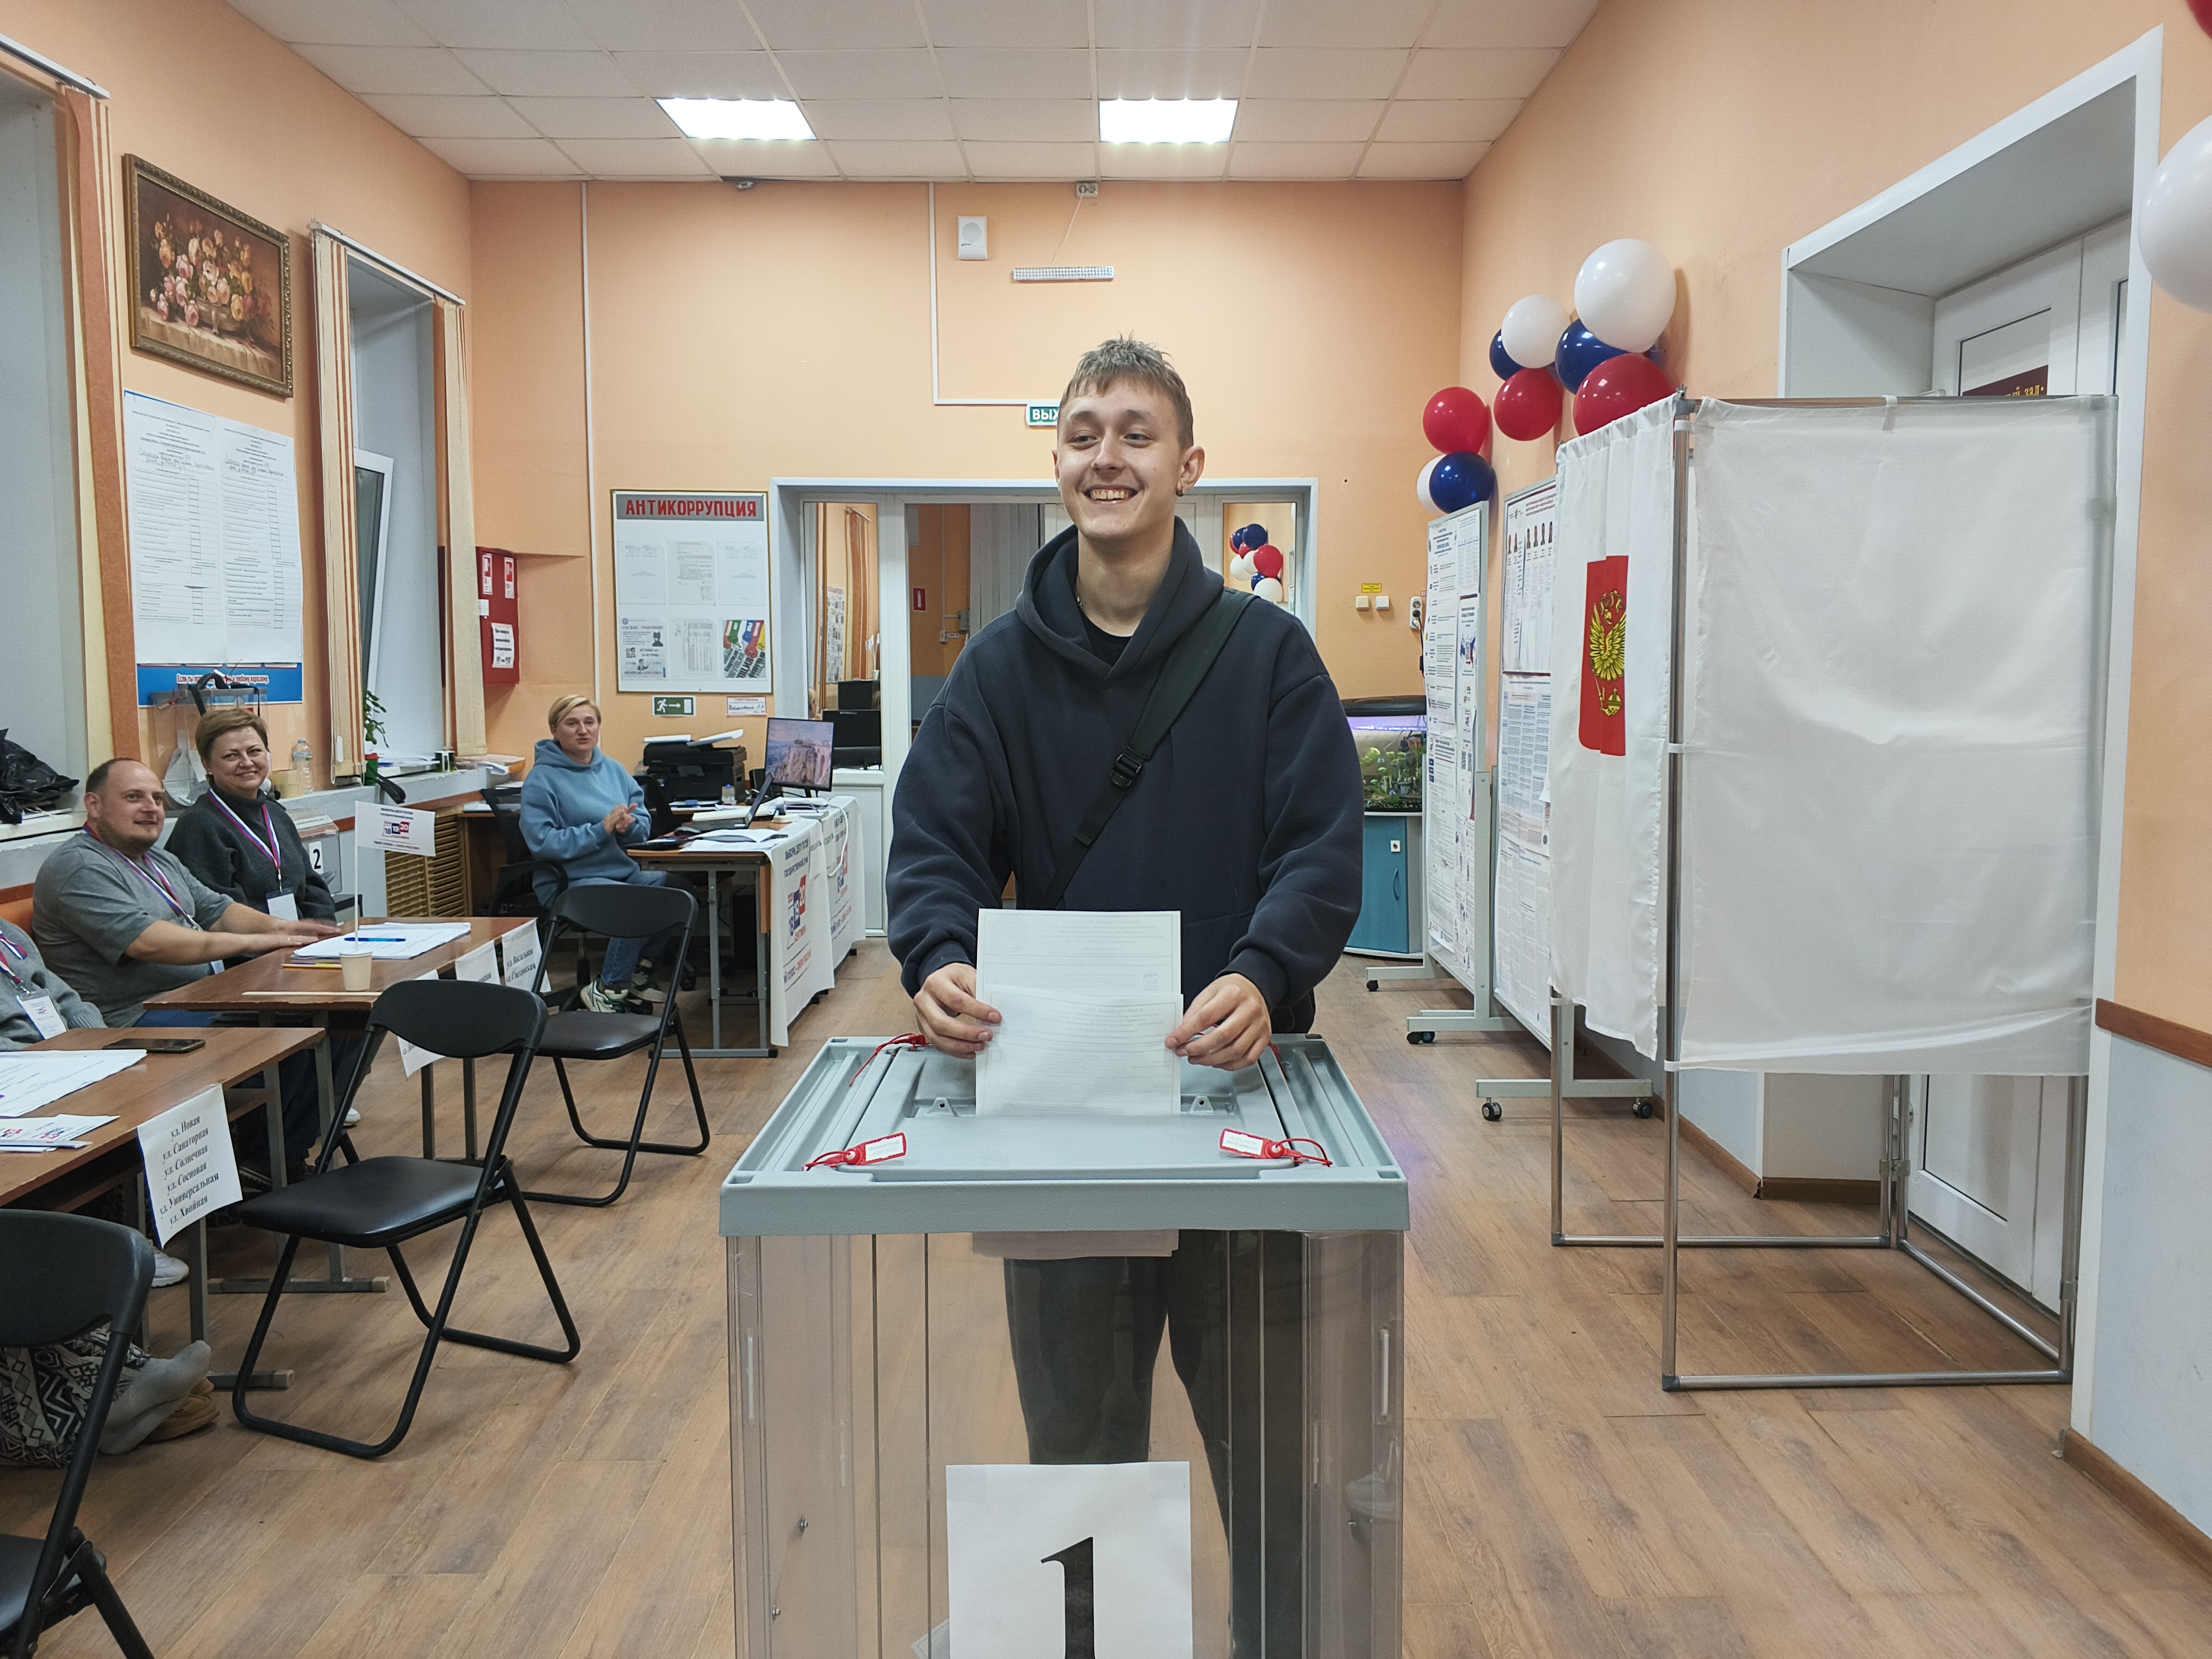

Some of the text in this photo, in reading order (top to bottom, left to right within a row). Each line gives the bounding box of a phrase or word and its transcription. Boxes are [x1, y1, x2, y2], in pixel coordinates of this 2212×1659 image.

[1032, 408, 1059, 420] ВЫХ
[626, 499, 756, 517] АНТИКОРРУПЦИЯ
[313, 849, 322, 869] 2
[799, 884, 806, 906] 20
[794, 899, 799, 921] 19
[181, 1116, 200, 1133] Новая
[174, 1128, 208, 1154] Санаторная
[175, 1145, 208, 1170] Солнечная
[178, 1161, 207, 1186] Сосновая
[169, 1173, 219, 1208] Универсальная
[180, 1195, 208, 1218] Хвойная
[1041, 1536, 1095, 1659] 1
